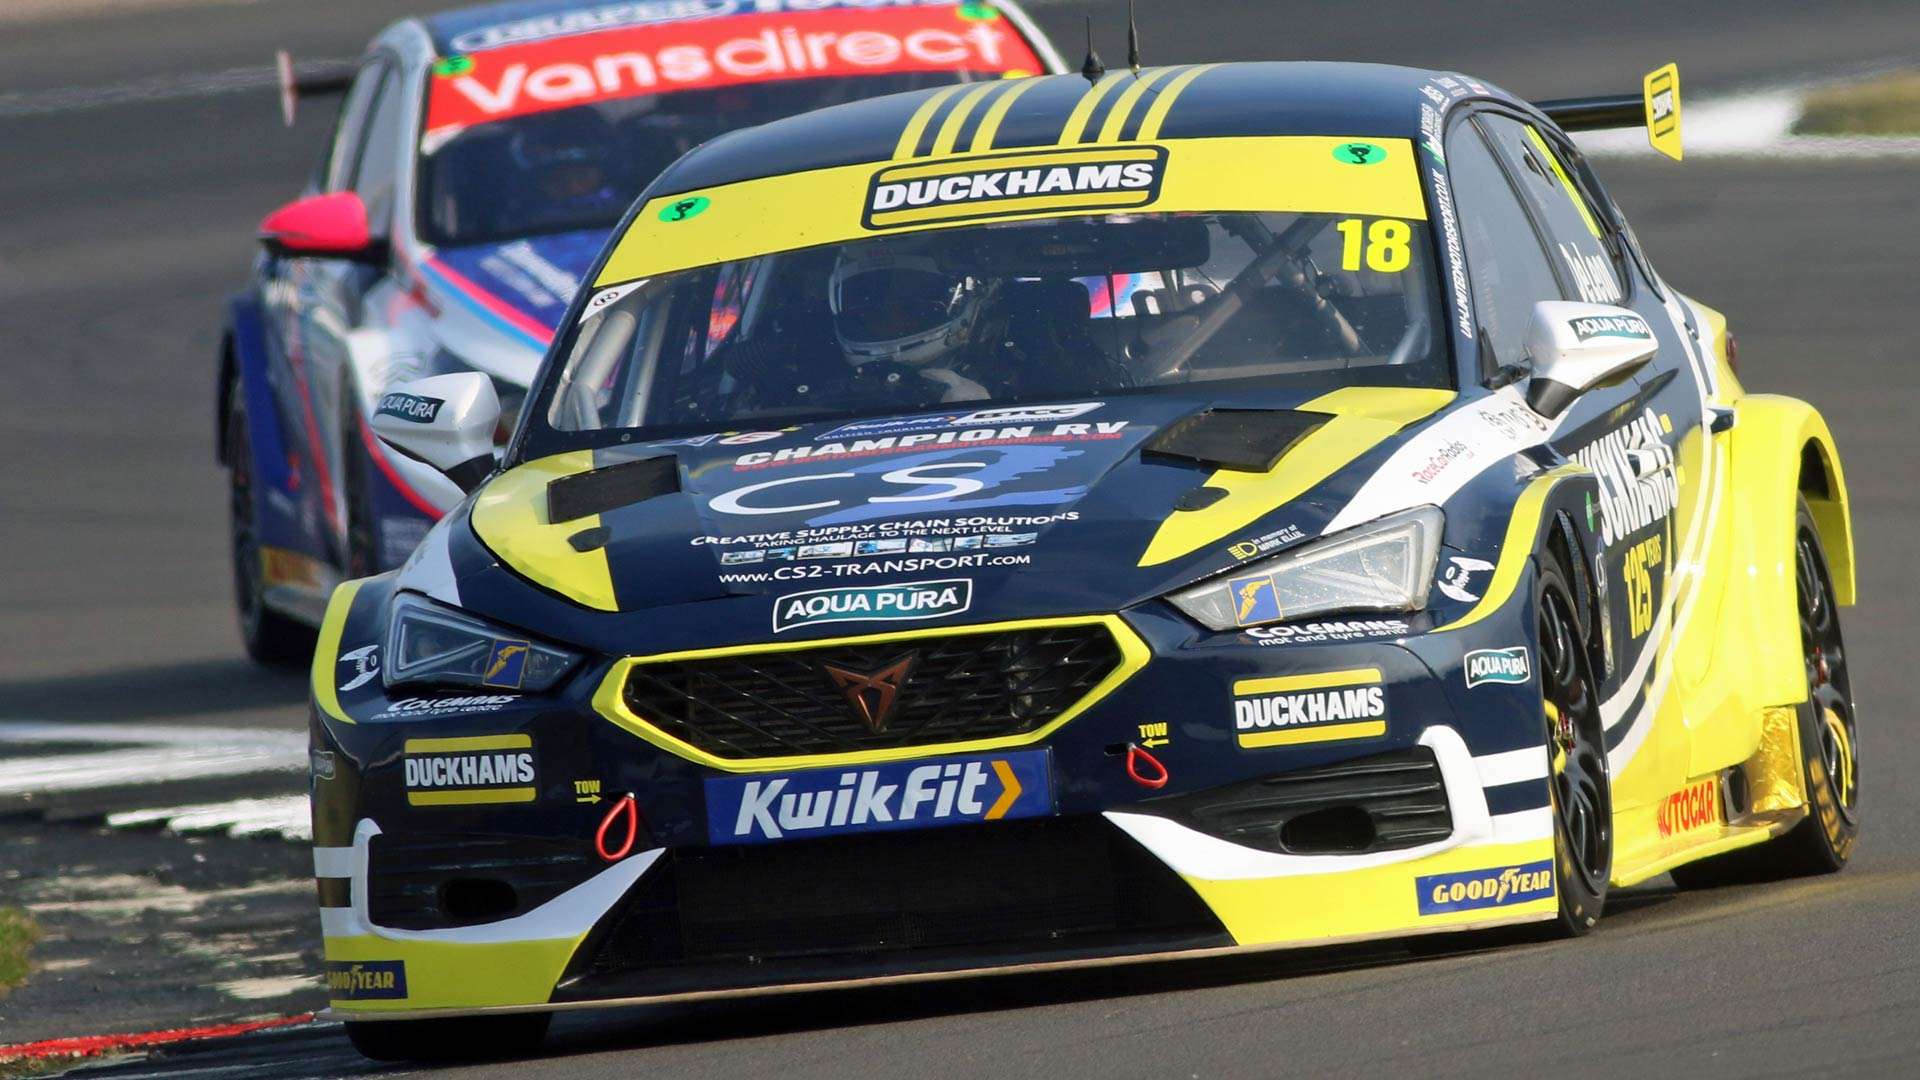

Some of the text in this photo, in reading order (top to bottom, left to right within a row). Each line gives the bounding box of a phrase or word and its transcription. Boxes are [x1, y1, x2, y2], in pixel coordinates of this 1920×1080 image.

[454, 24, 1003, 113] Vansdirect
[873, 163, 1154, 210] DUCKHAMS
[1337, 219, 1411, 272] 18
[1575, 318, 1617, 336] AQUA
[402, 398, 437, 417] PURA
[735, 425, 1034, 466] CHAMPION
[1051, 421, 1129, 436] RV
[690, 511, 1080, 546] CREATIVE SUPPLY CHAIN SOLUTIONS
[754, 525, 1013, 549] TAKING HAULAGE TO THE NEXT LEVEL
[784, 586, 960, 621] AQUA PURA
[1623, 542, 1653, 640] 125
[1245, 619, 1410, 639] COLEMANS
[1258, 637, 1292, 647] mot
[1295, 632, 1328, 643] and
[1329, 631, 1366, 642] tyre
[1470, 655, 1527, 679] AQUA PURA
[1234, 686, 1385, 730] DUCKHAMS
[1138, 722, 1168, 738] TOW
[405, 753, 535, 787] DUCKHAMS
[574, 780, 600, 793] TOW
[1432, 869, 1551, 904] GOODYEAR
